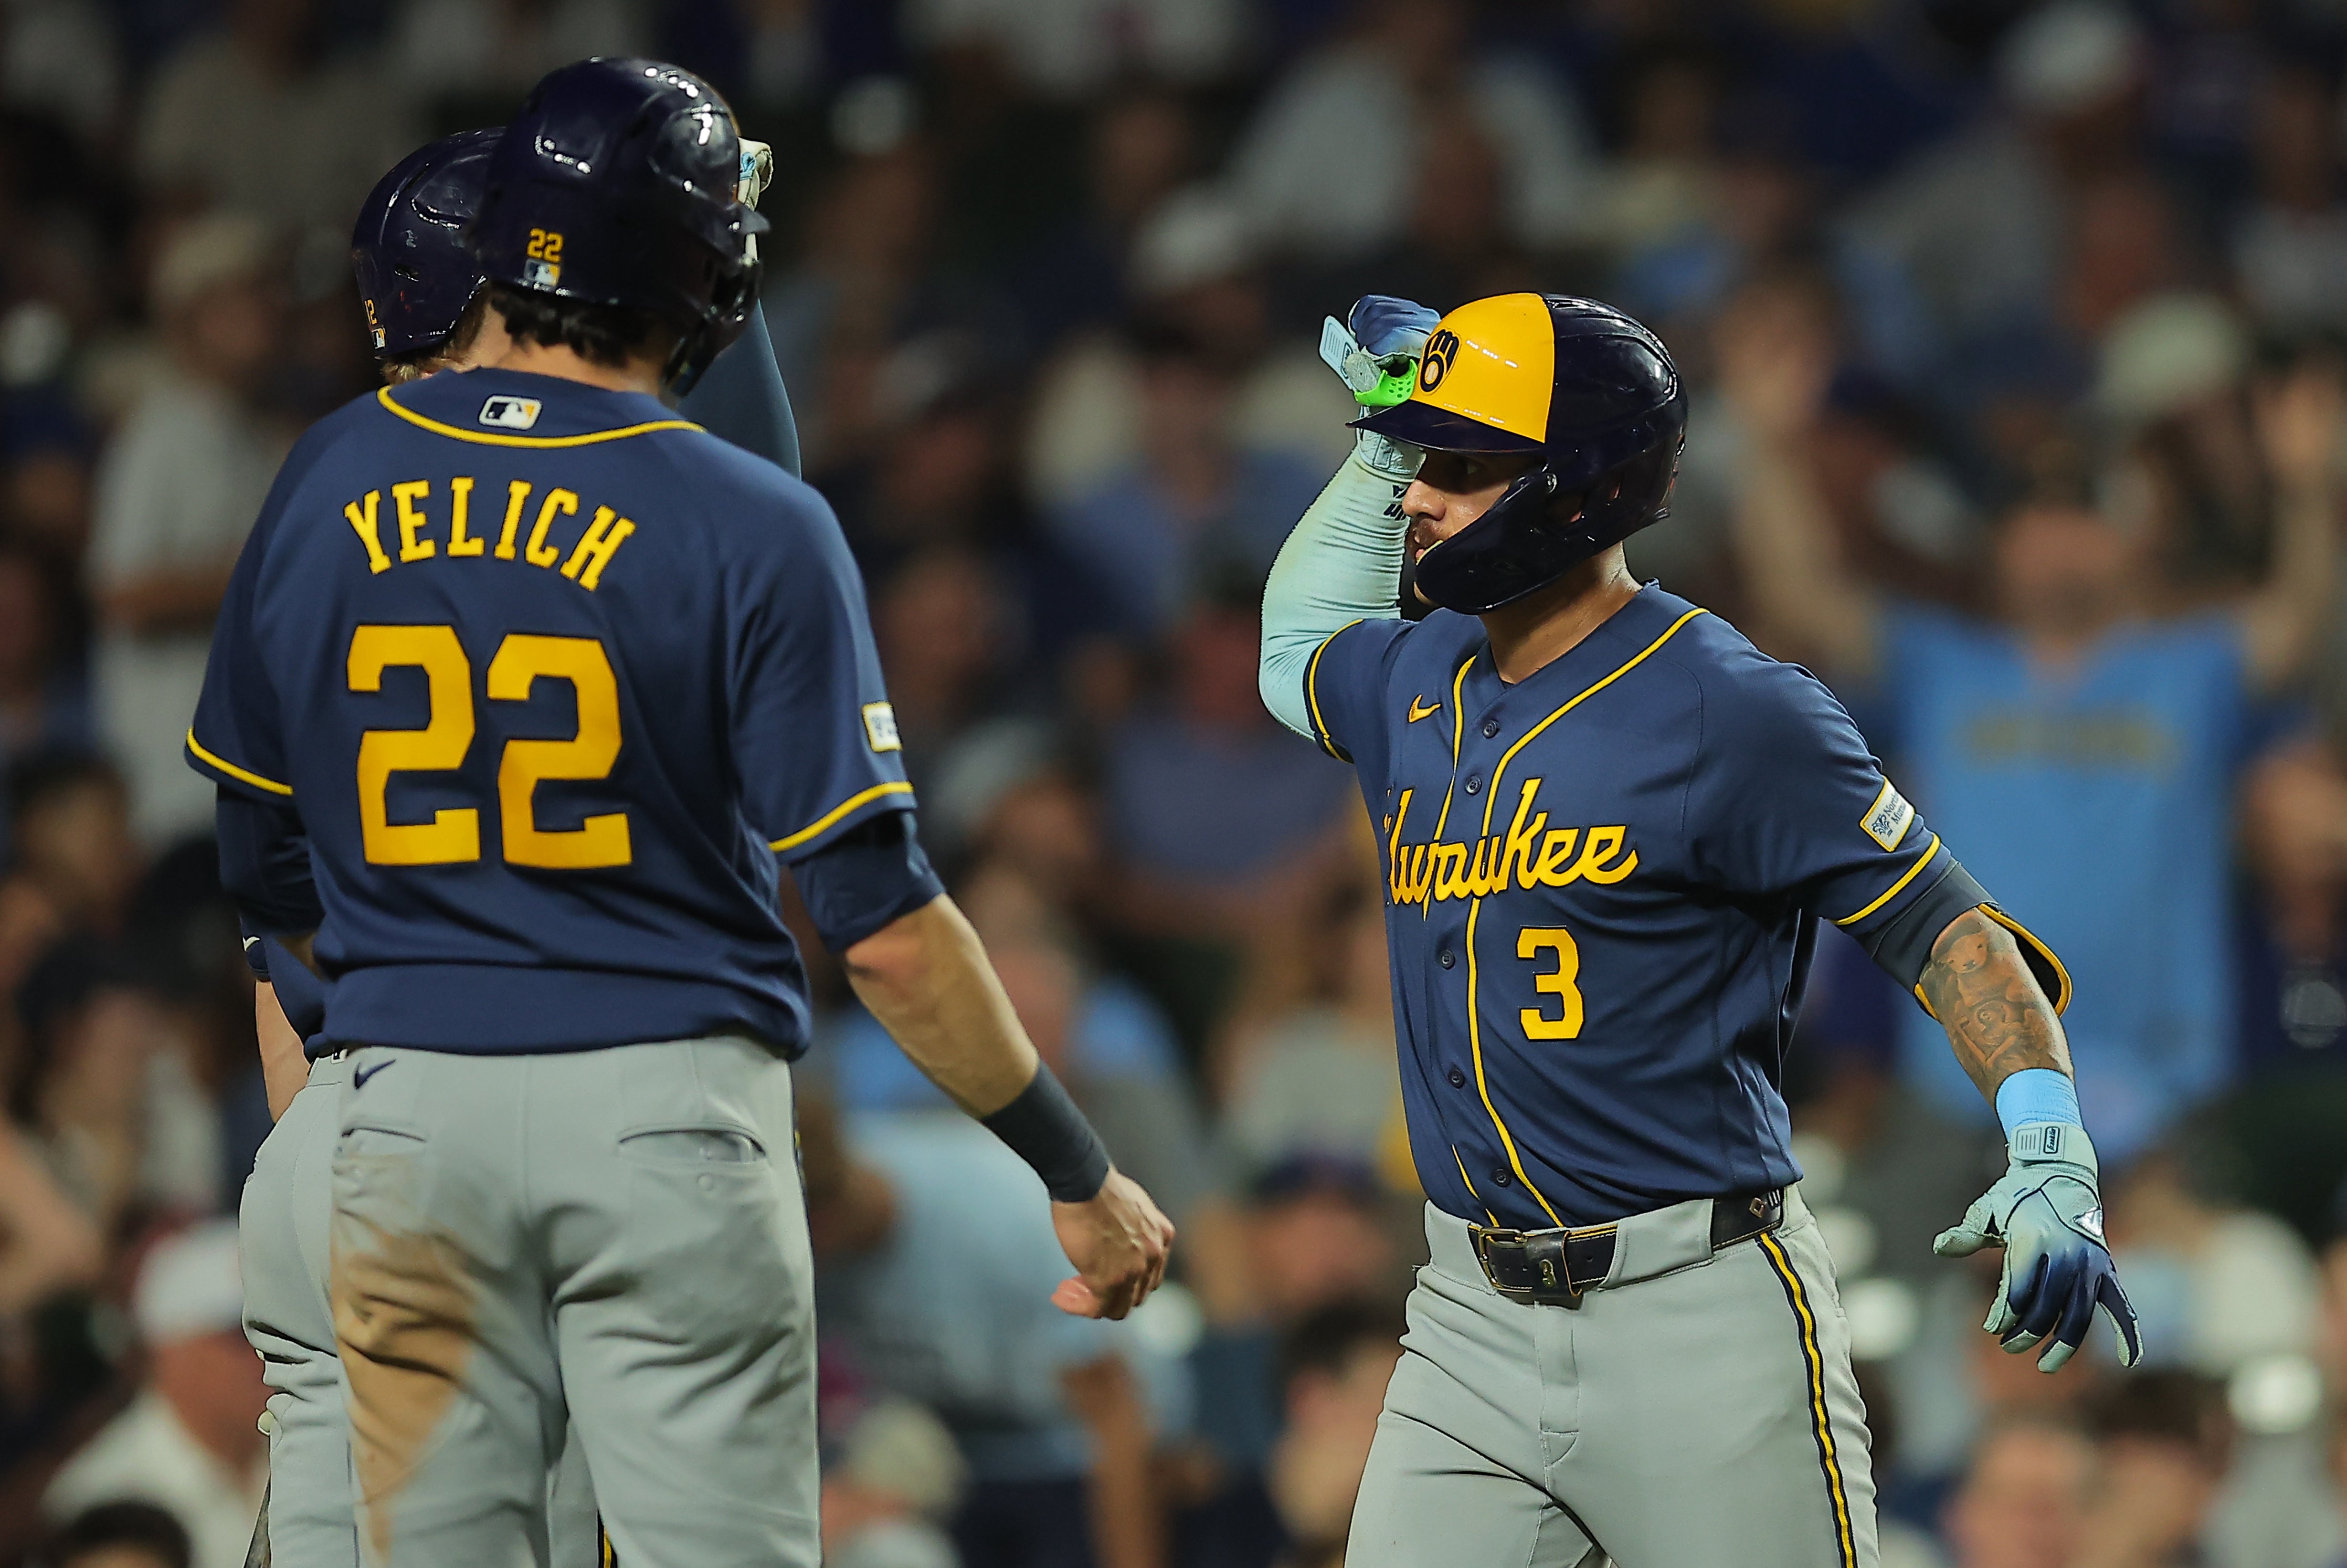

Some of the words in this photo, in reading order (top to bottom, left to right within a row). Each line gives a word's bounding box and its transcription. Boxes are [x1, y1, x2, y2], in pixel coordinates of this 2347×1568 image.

[527, 227, 564, 263] 22
[364, 299, 378, 325] 2
[344, 476, 636, 591] YELICH
[347, 624, 632, 870] 22
[1384, 778, 1639, 905] lwaukee
[1517, 927, 1586, 1042] 3
